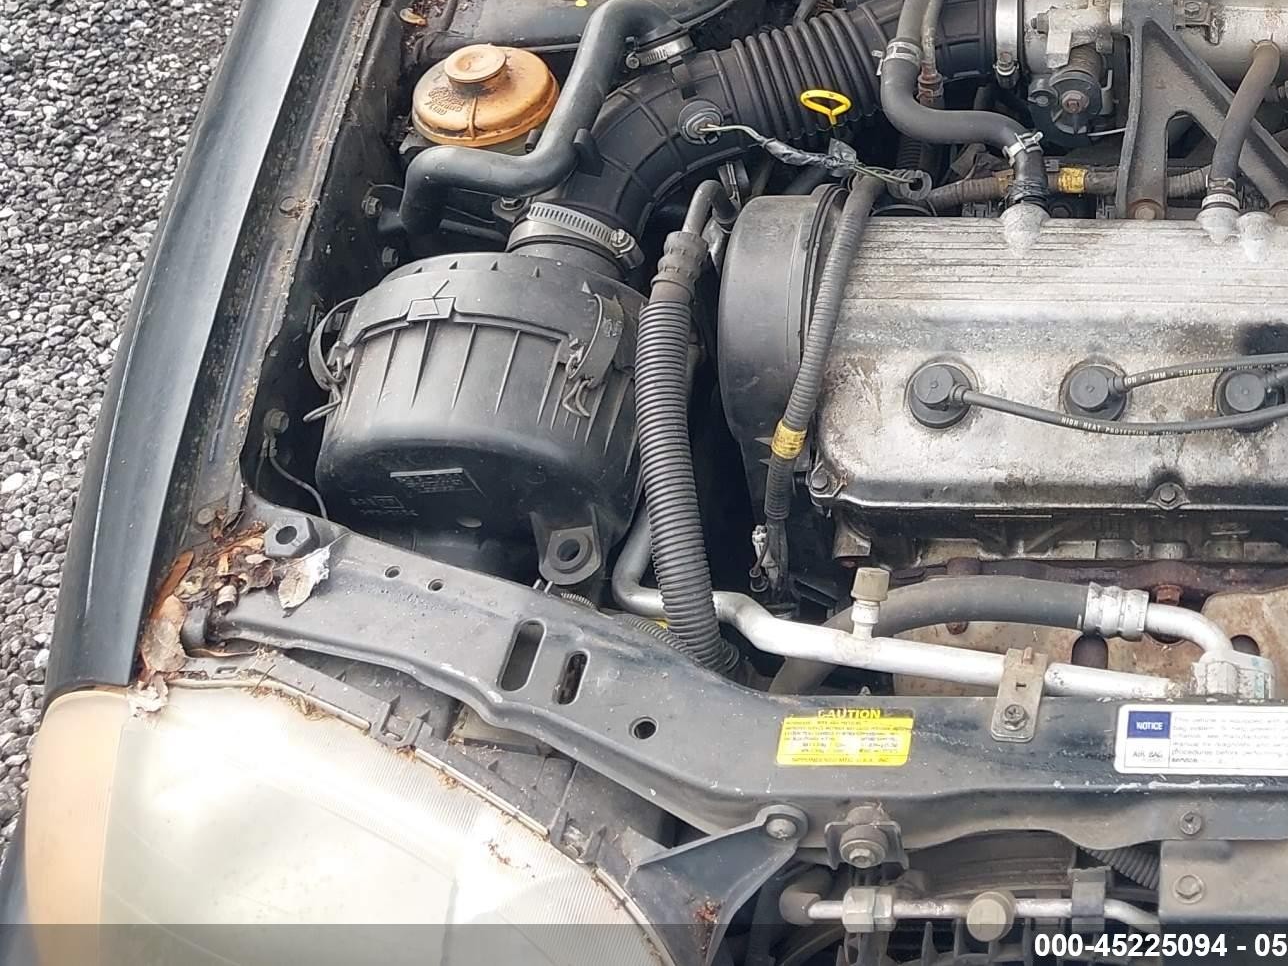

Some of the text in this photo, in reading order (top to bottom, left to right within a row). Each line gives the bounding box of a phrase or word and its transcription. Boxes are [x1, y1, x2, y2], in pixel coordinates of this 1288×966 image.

[1149, 371, 1167, 381] 7MM
[1061, 417, 1149, 436] HIGH HEAT PROTECTION
[817, 708, 881, 719] CAUTION
[1136, 721, 1163, 731] NOTICE
